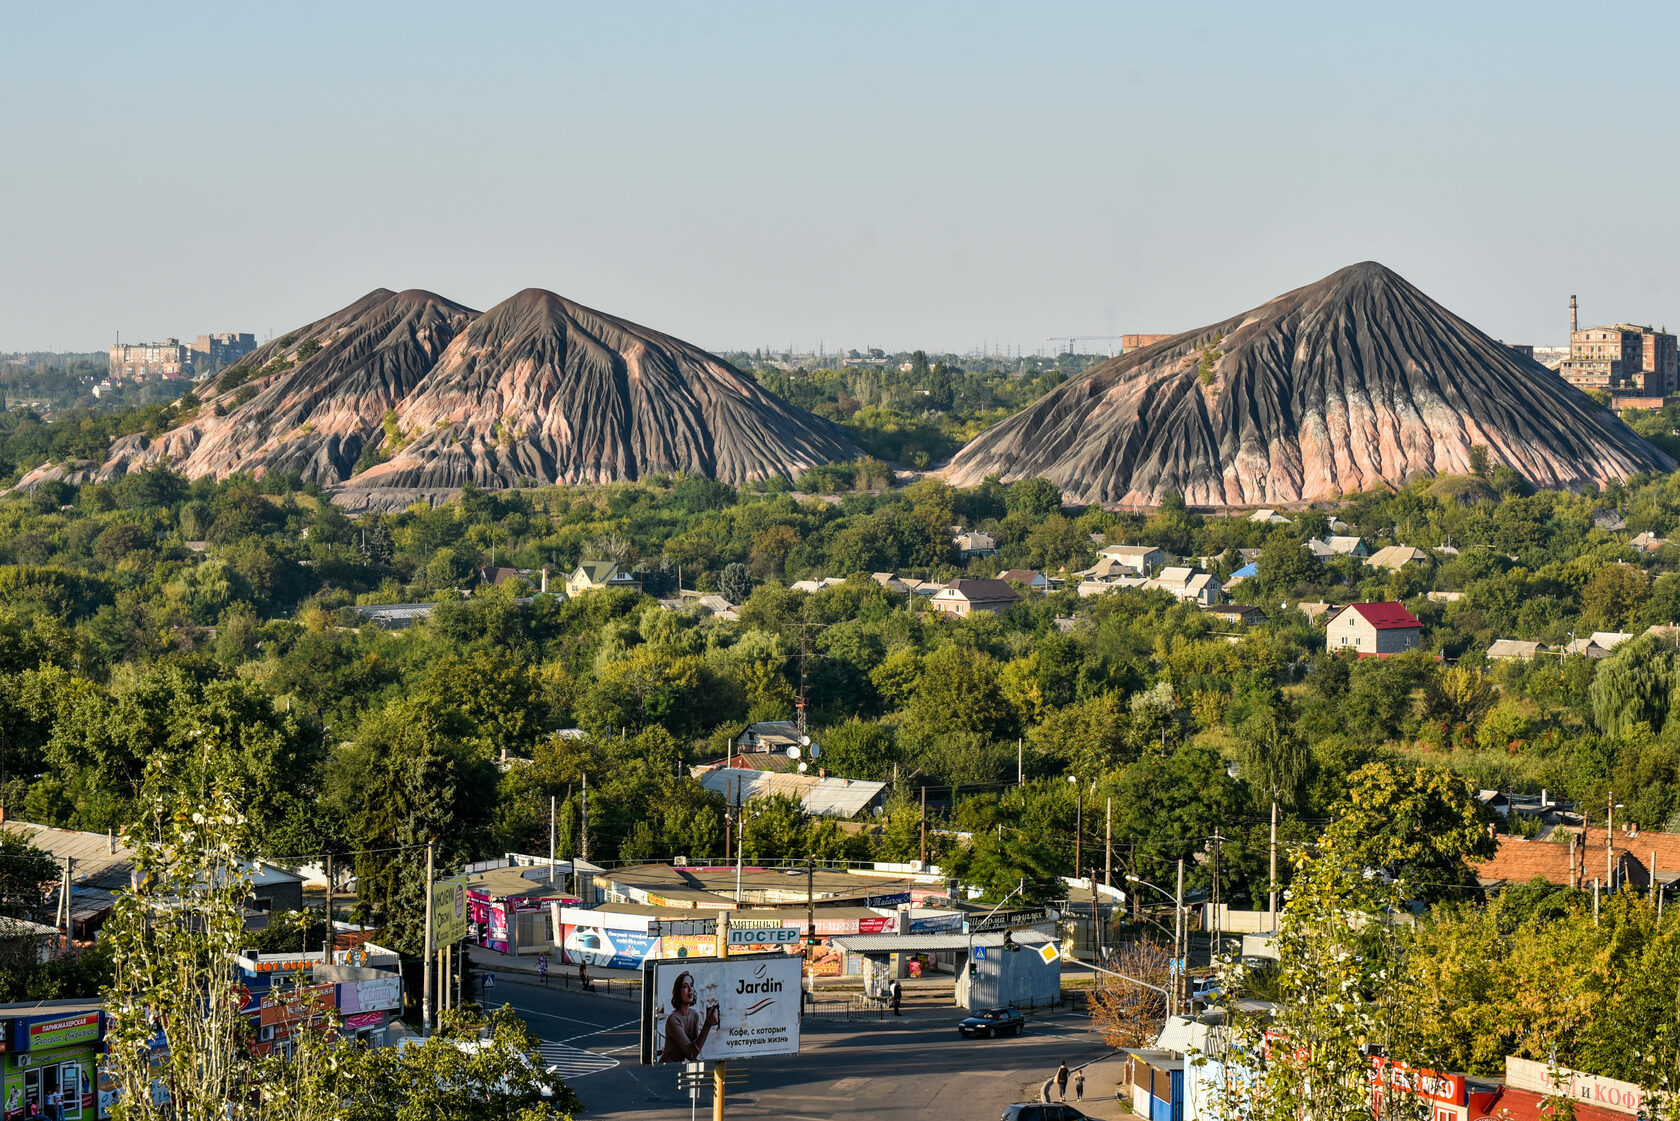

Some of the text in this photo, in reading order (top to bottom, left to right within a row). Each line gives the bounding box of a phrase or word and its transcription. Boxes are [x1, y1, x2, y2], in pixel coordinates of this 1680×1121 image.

[728, 919, 780, 929] АМЯТНИКИ
[732, 930, 797, 942] ПОСТЕР
[736, 977, 782, 994] Jardin
[42, 1018, 87, 1032] ПАРИКМАХЕРСКАЯ
[729, 1027, 750, 1038] Кофе,
[756, 1026, 787, 1035] которым
[726, 1036, 789, 1048] чувствуешь жизнь
[1540, 1071, 1576, 1097] ЧЙ
